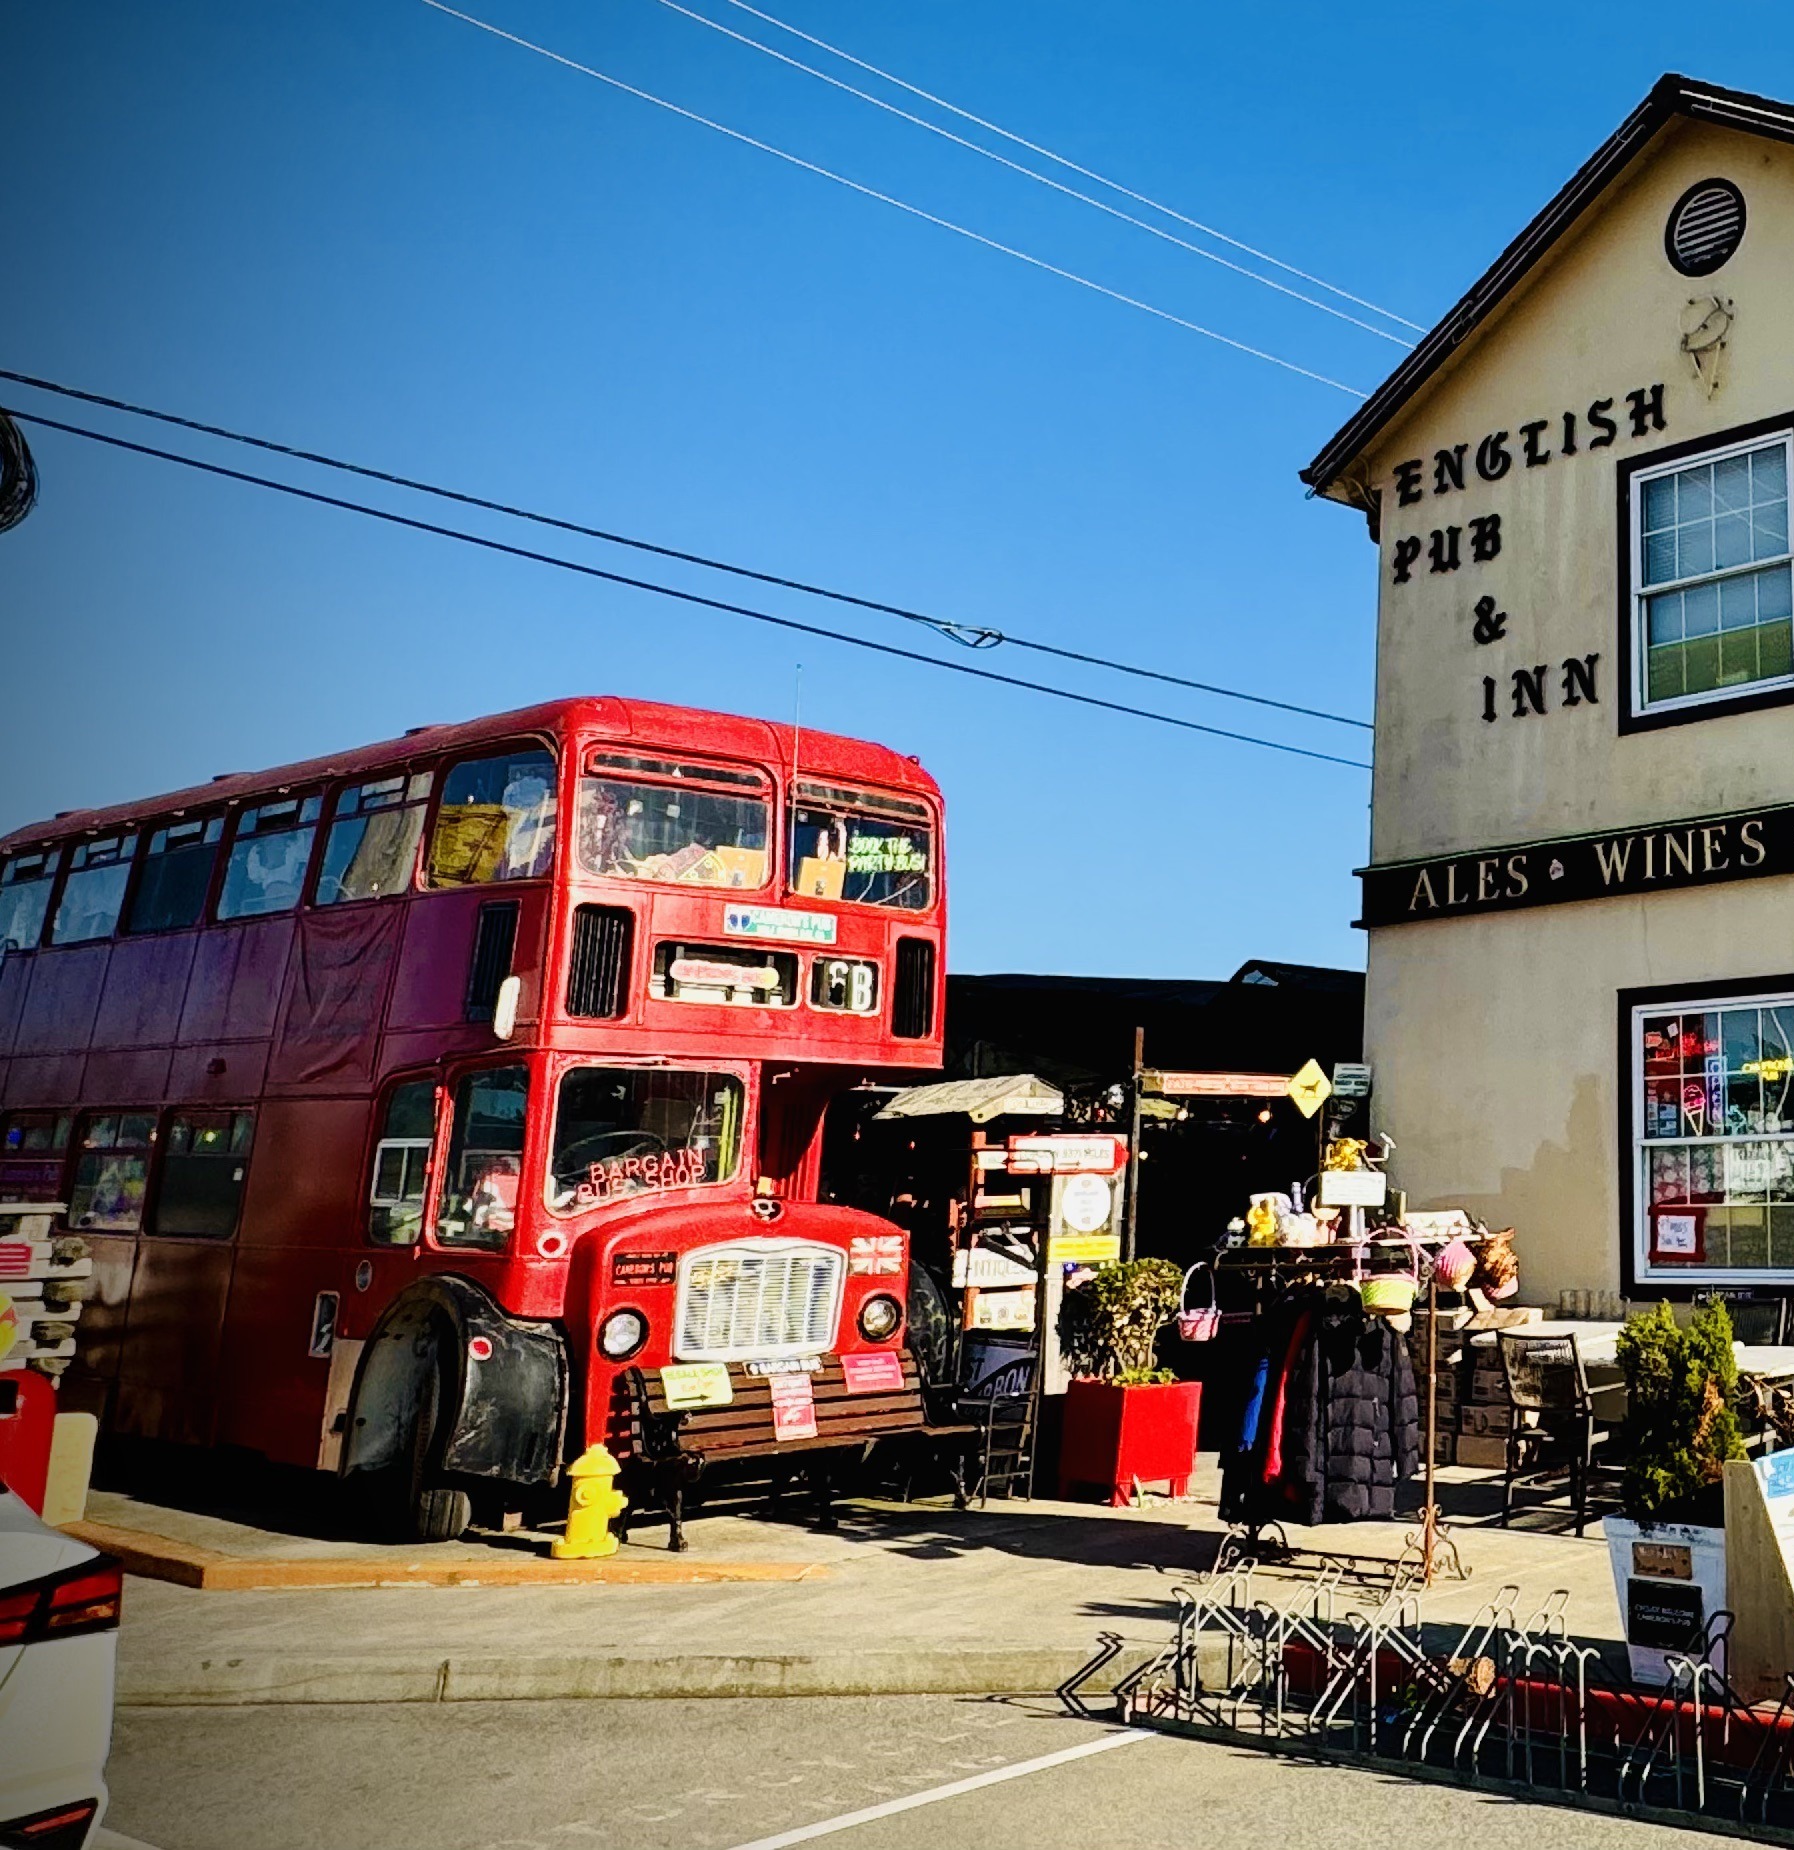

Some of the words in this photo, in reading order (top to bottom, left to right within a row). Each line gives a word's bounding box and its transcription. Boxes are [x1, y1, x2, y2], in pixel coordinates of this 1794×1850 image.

[1392, 384, 1667, 508] ENGLISH
[1393, 513, 1501, 584] PUB
[1473, 595, 1507, 645] &
[1481, 653, 1599, 722] INN
[1408, 855, 1529, 911] ALES
[1593, 820, 1766, 886] WINES
[589, 1149, 704, 1183] BARGAIN
[645, 1164, 707, 1189] SHOP
